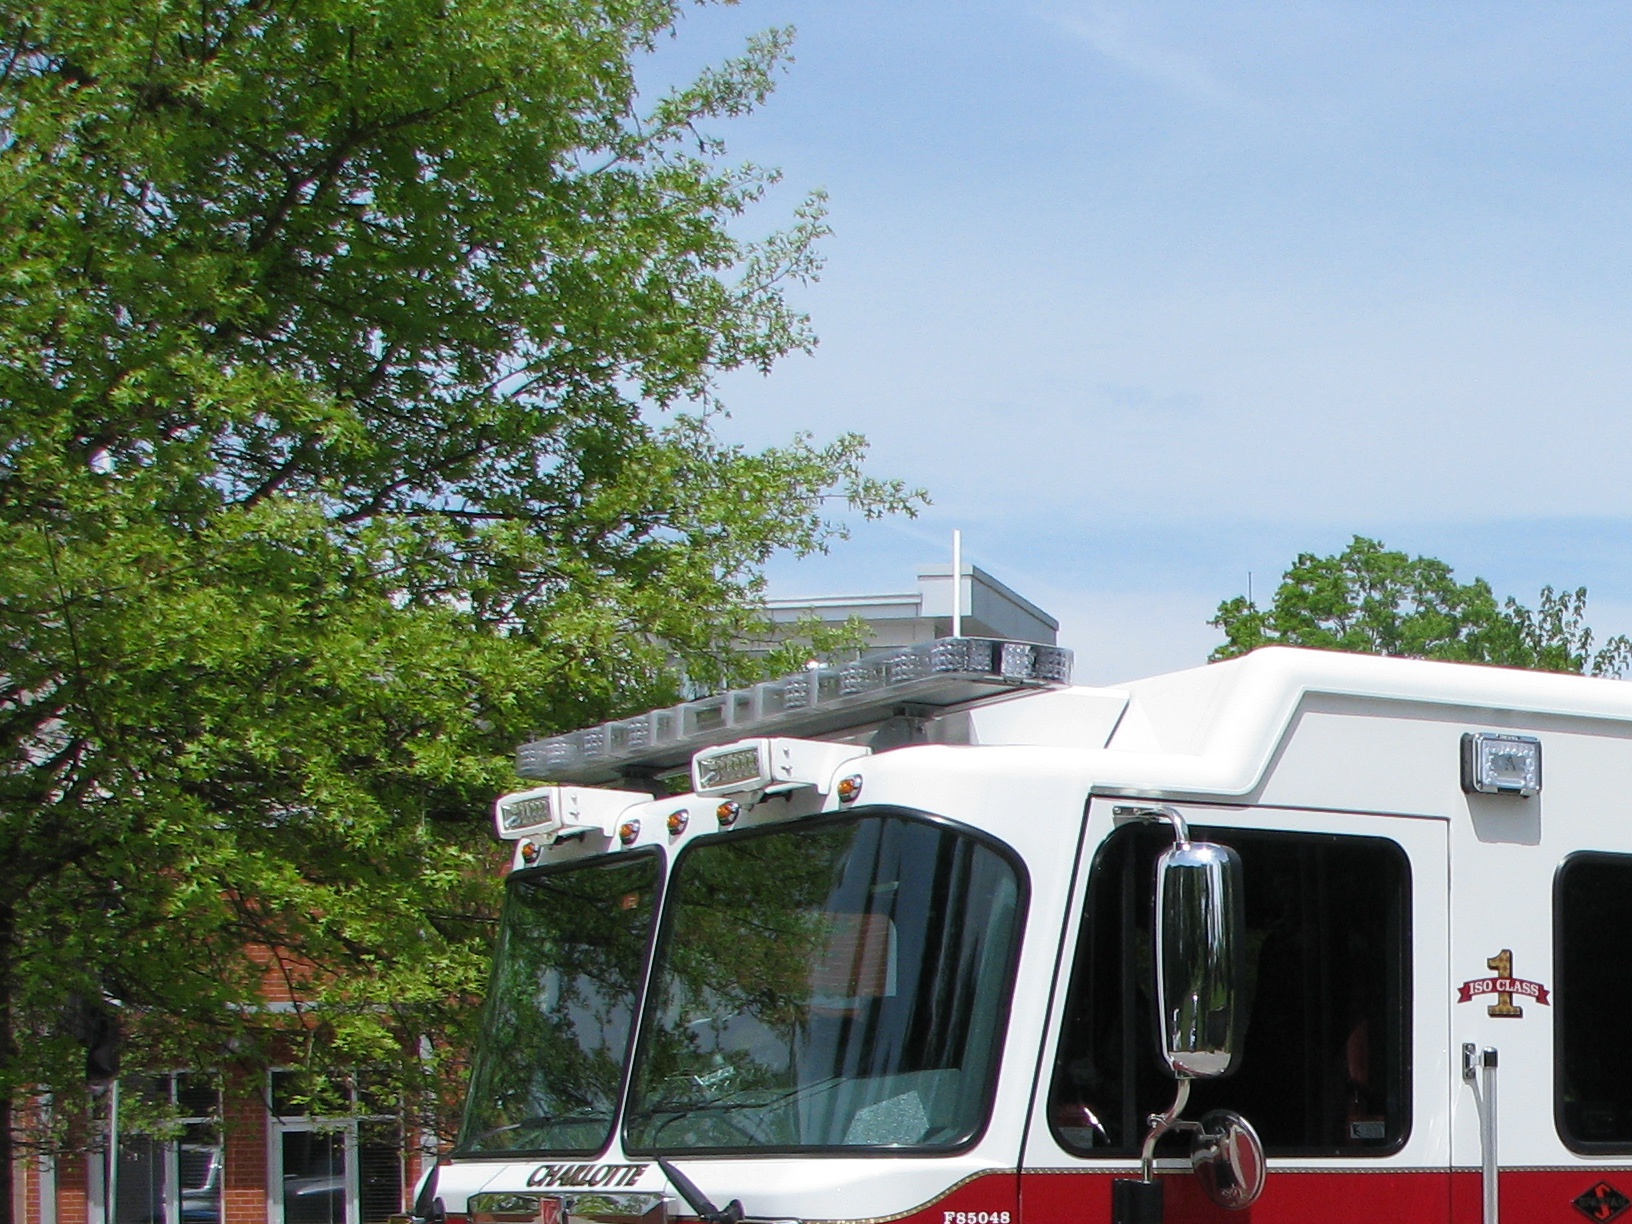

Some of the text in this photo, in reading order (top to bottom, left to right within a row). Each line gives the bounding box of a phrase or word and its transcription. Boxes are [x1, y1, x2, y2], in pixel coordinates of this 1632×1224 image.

[1468, 979, 1539, 997] ISO CLASS
[526, 1163, 651, 1188] CHARLOTTE
